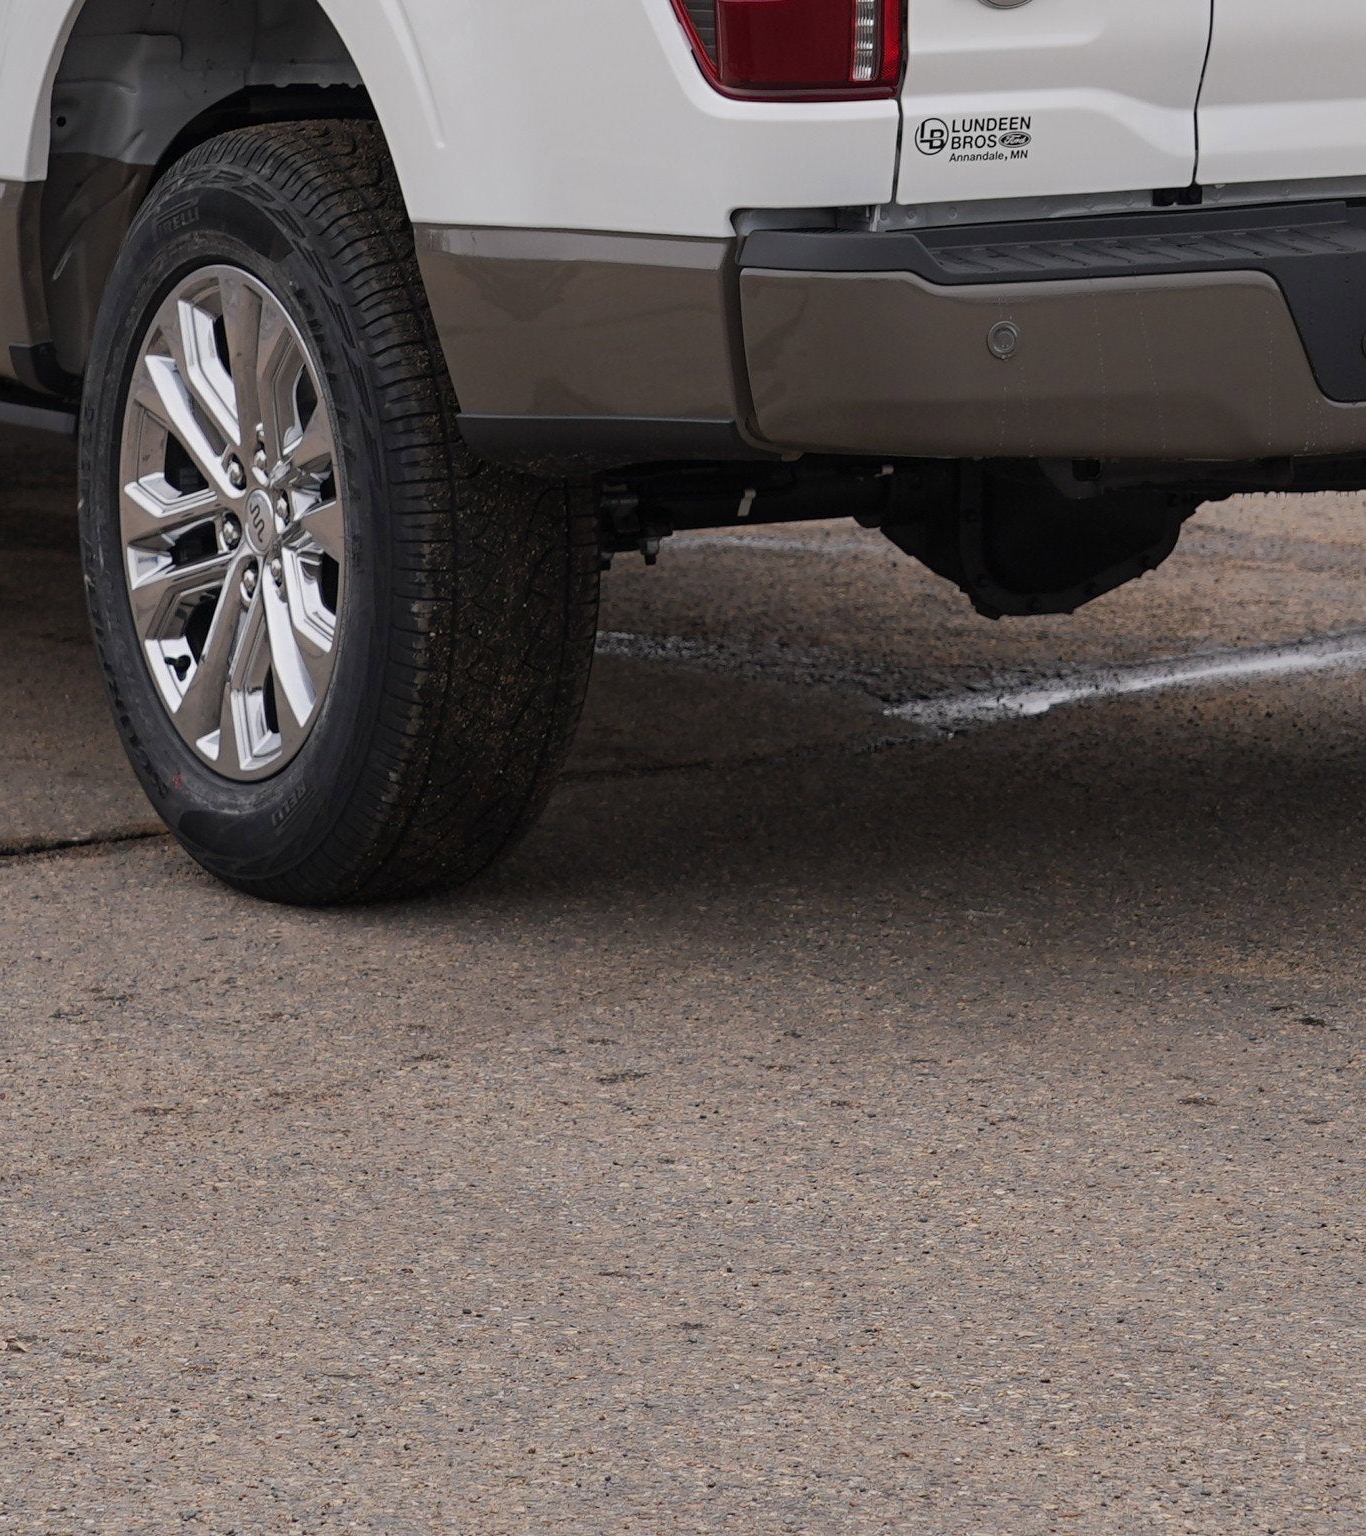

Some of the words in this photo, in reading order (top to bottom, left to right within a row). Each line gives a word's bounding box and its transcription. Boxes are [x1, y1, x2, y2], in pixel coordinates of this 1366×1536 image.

[951, 116, 1032, 133] LUNDEEN
[951, 134, 997, 150] BROS
[948, 150, 1008, 162] Annandale,
[1010, 150, 1028, 159] MN
